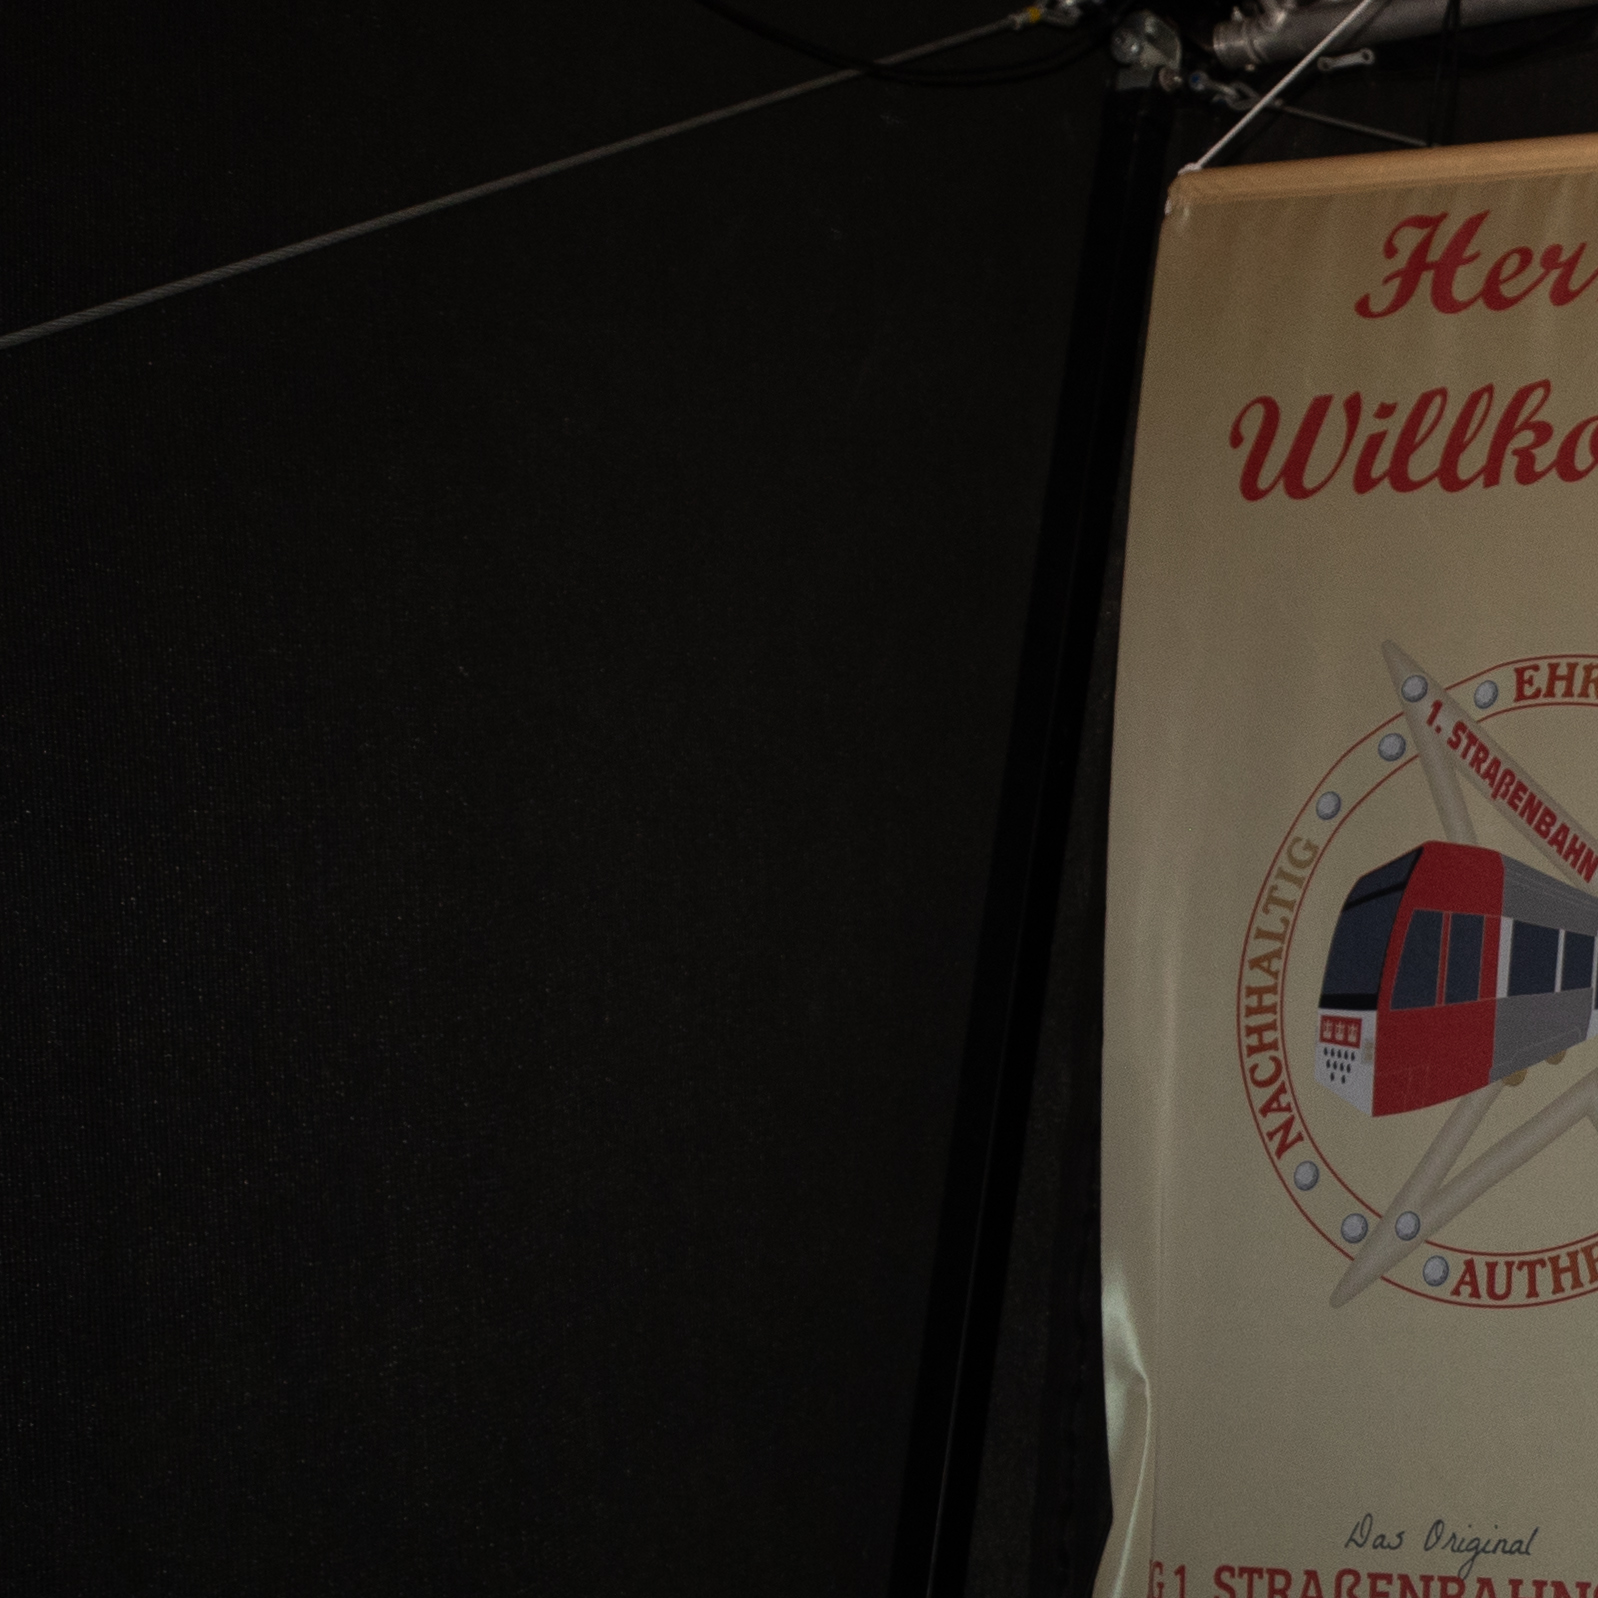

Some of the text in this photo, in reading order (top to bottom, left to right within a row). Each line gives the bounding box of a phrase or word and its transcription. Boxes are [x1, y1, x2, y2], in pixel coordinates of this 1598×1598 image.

[1425, 700, 1443, 733] 1.
[1244, 835, 1321, 1160] NACHHALTIG
[1344, 1512, 1539, 1581] Das Original
